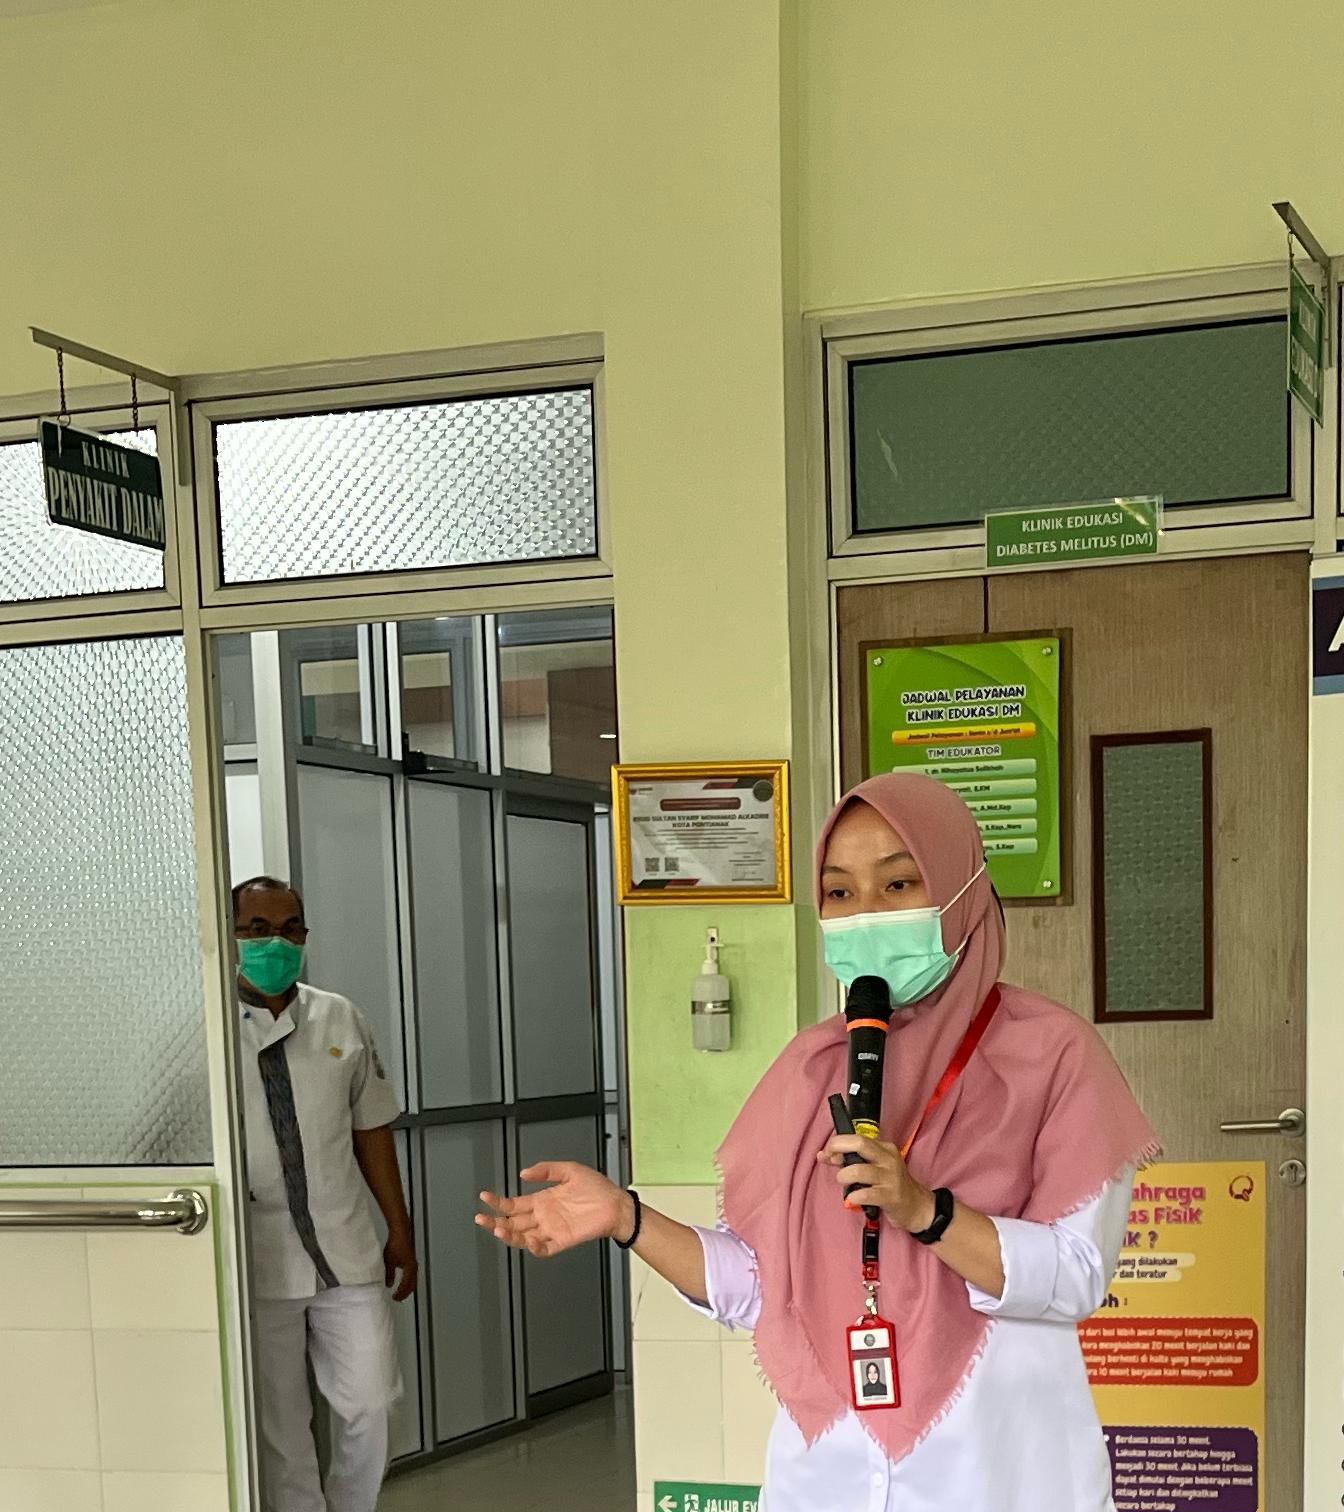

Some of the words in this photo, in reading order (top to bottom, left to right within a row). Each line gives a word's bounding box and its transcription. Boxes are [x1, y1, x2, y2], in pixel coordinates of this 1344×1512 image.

[82, 441, 129, 478] KLINIK
[48, 467, 118, 531] PENYAKIT
[121, 487, 164, 542] DALAM
[1022, 518, 1063, 532] KLINIK
[1067, 512, 1122, 528] EDUKASI
[997, 541, 1057, 557] DIABETES
[1061, 535, 1116, 551] MELITUS
[1120, 531, 1154, 549] (DM)
[903, 690, 950, 704] JADWAL
[955, 686, 1025, 702] PELAYANAN
[907, 709, 944, 722] KLINIK
[948, 706, 998, 720] EDUKASI
[1002, 704, 1020, 718] DM
[928, 749, 944, 759] TIM
[948, 746, 1000, 758] EDUKATOR
